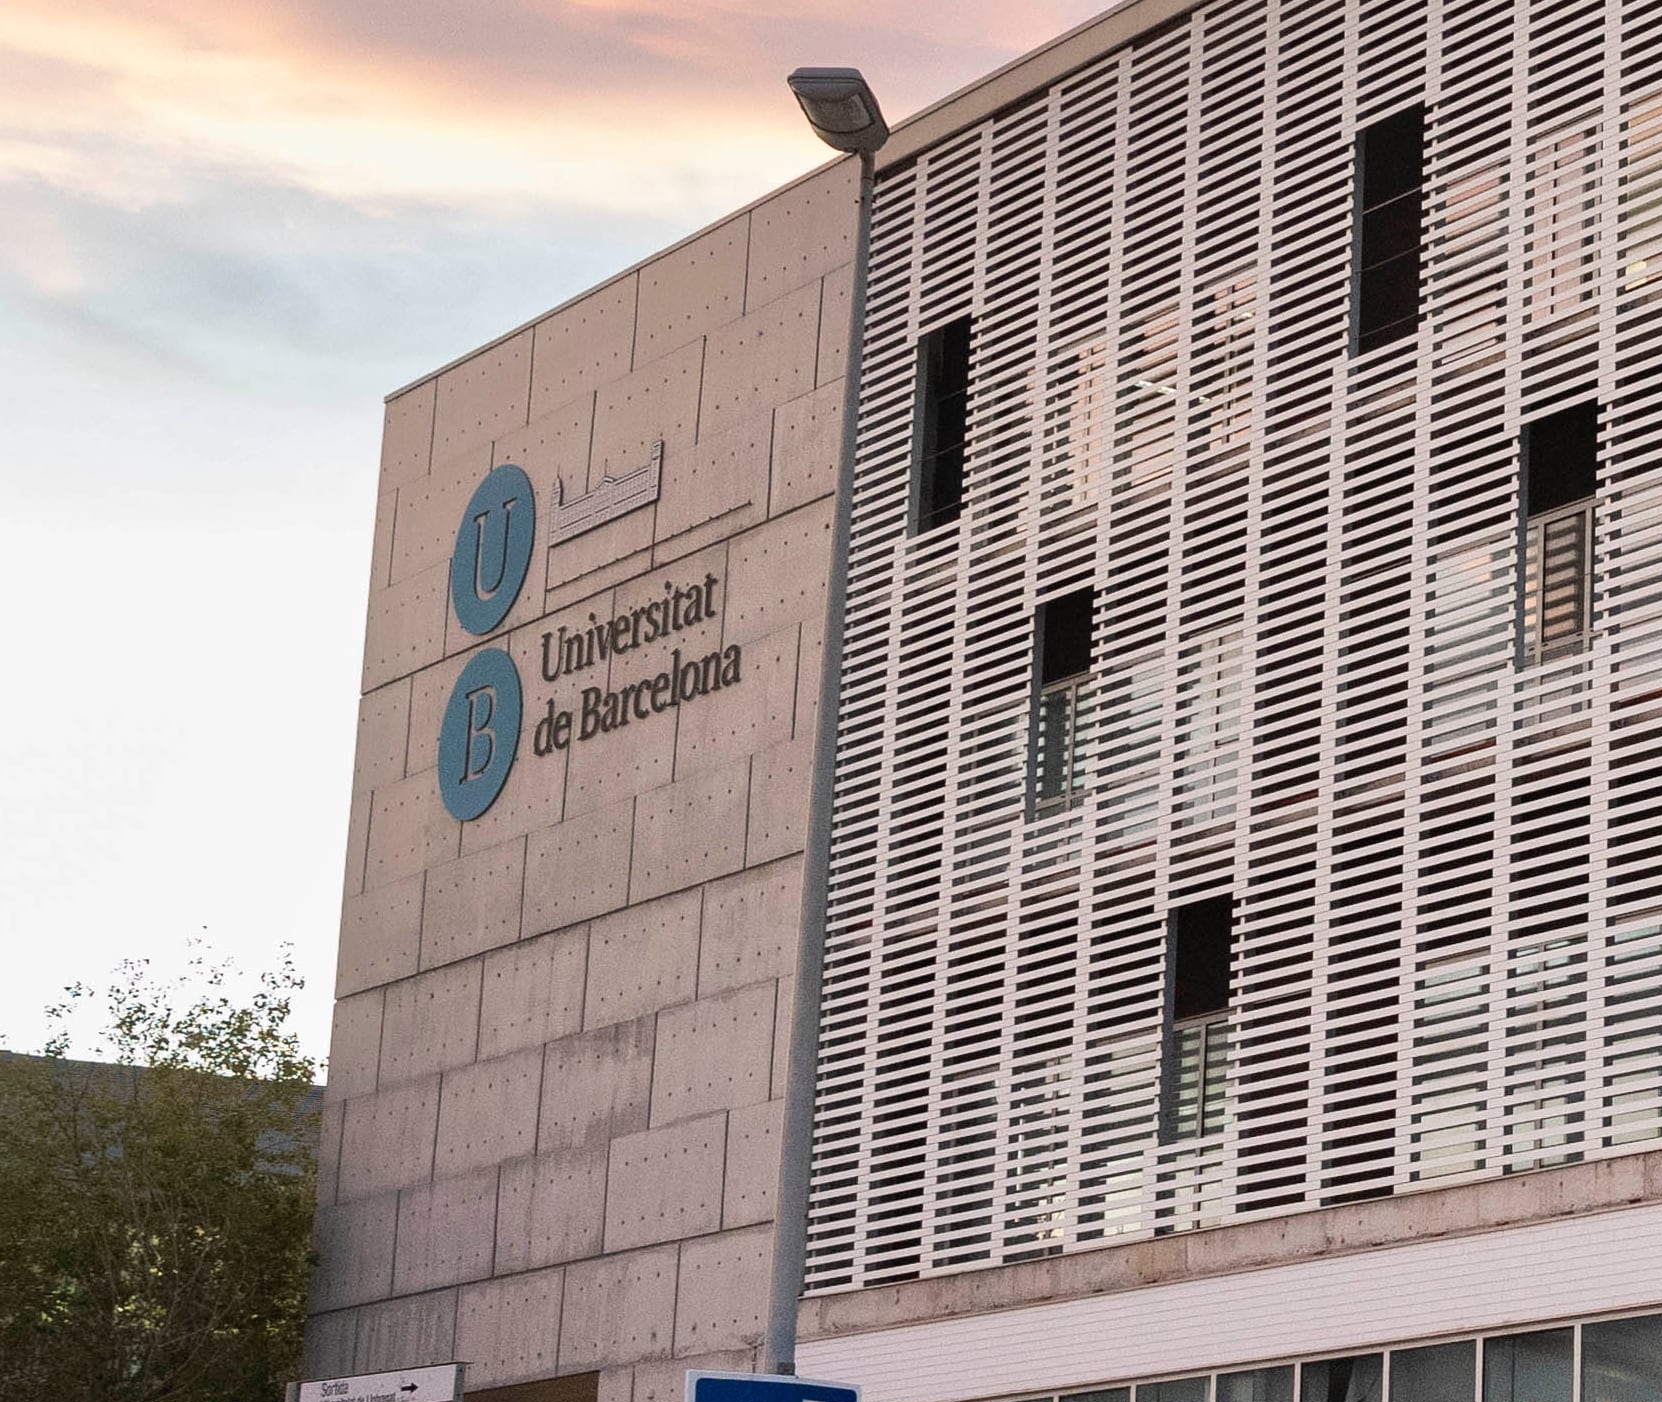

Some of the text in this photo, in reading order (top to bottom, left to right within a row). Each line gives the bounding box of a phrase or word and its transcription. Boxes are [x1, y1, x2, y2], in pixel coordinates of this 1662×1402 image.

[473, 497, 518, 599] U
[540, 572, 719, 682] Universitat
[459, 684, 498, 785] B
[533, 644, 742, 758] de Barcelona
[321, 1381, 349, 1397] Sortida
